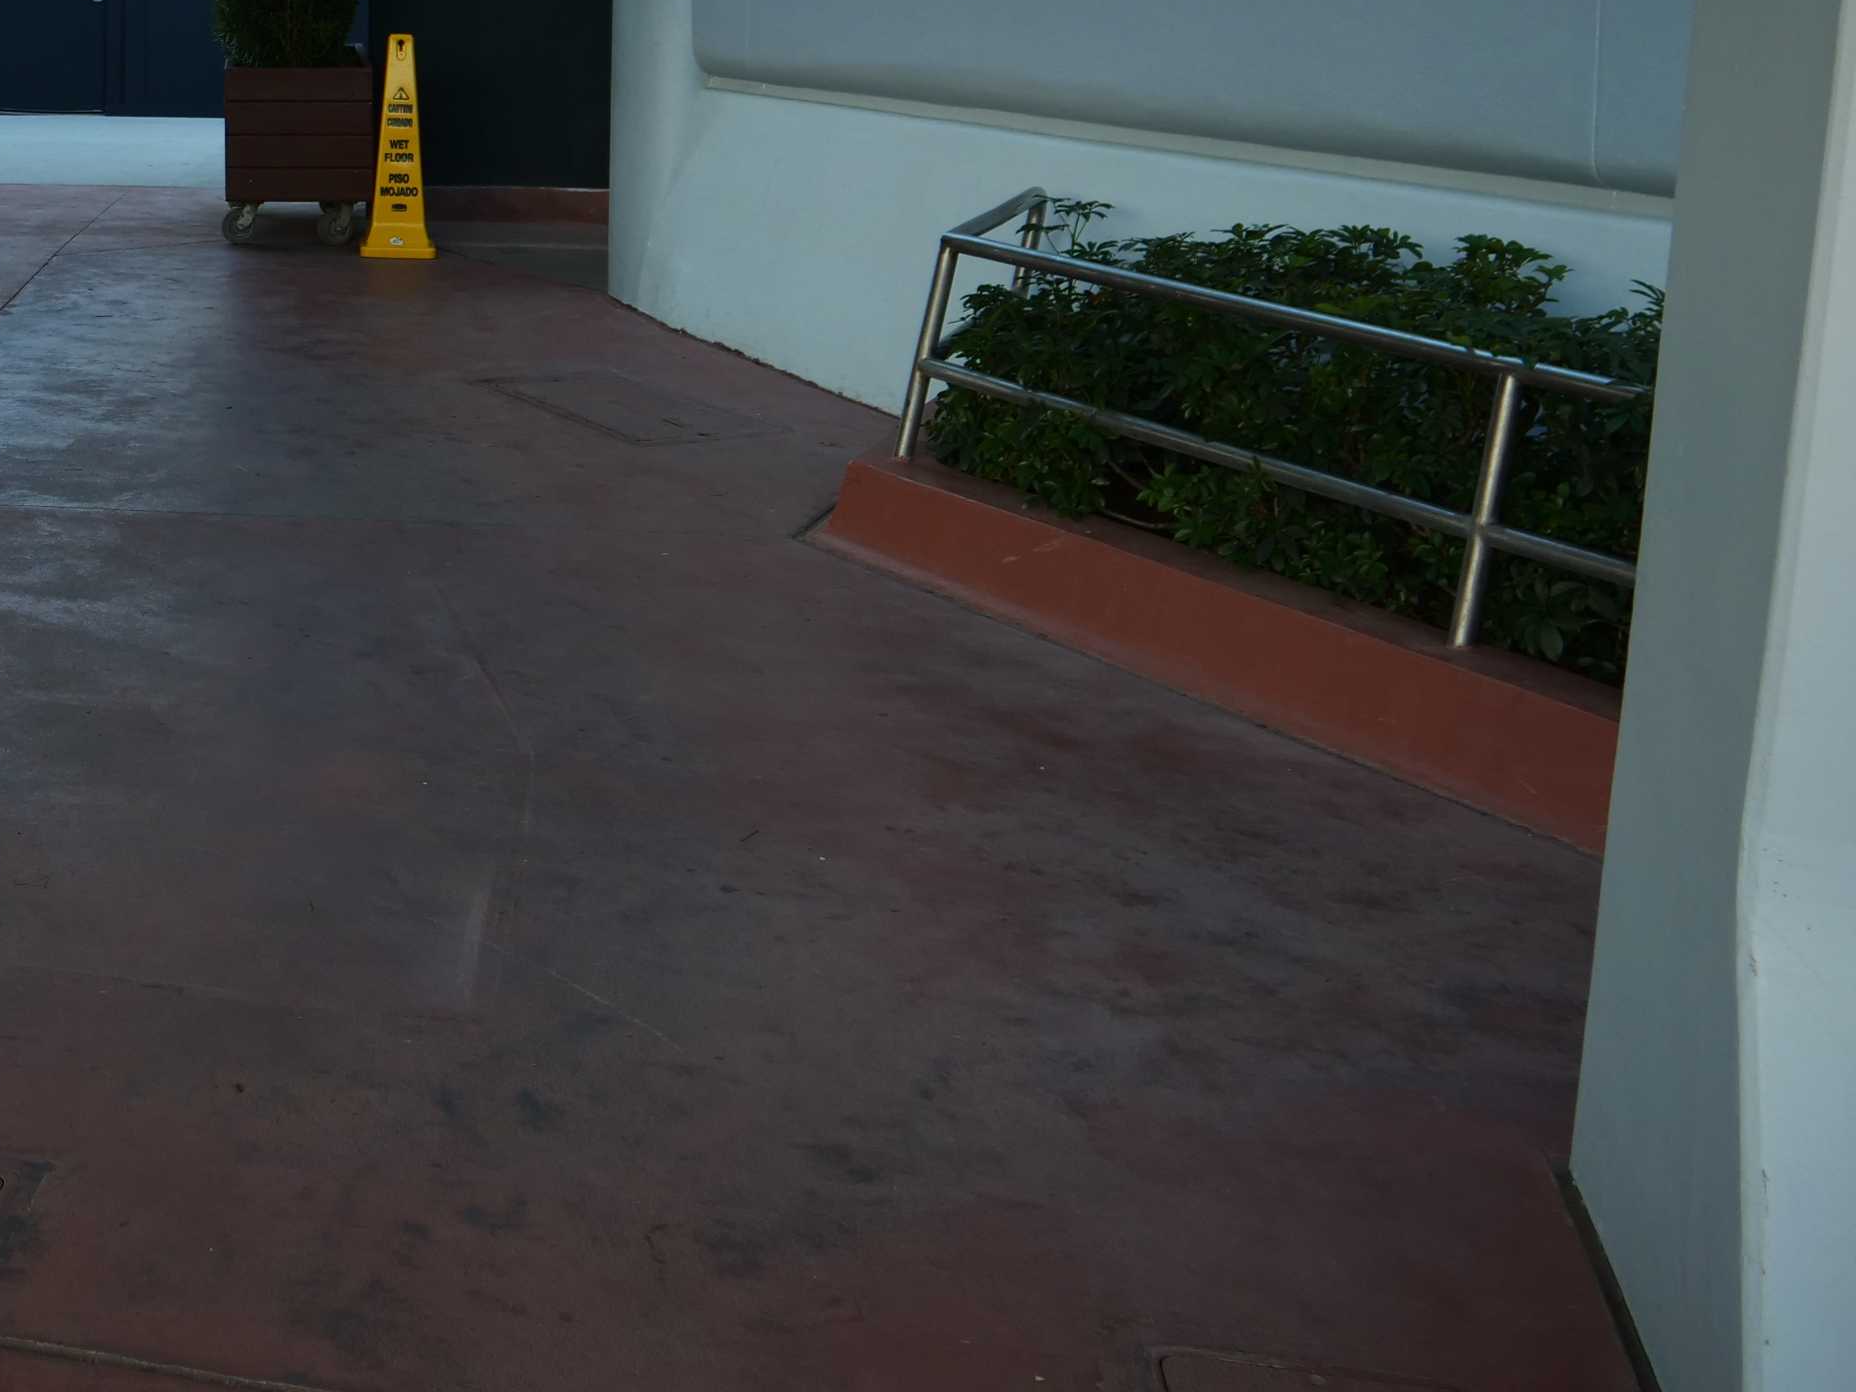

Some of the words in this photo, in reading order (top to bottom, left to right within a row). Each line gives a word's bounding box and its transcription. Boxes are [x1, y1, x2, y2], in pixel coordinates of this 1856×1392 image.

[389, 139, 409, 149] WET
[384, 153, 414, 163] FLOOR
[389, 174, 409, 184] PISO
[381, 187, 418, 197] MOJADO
